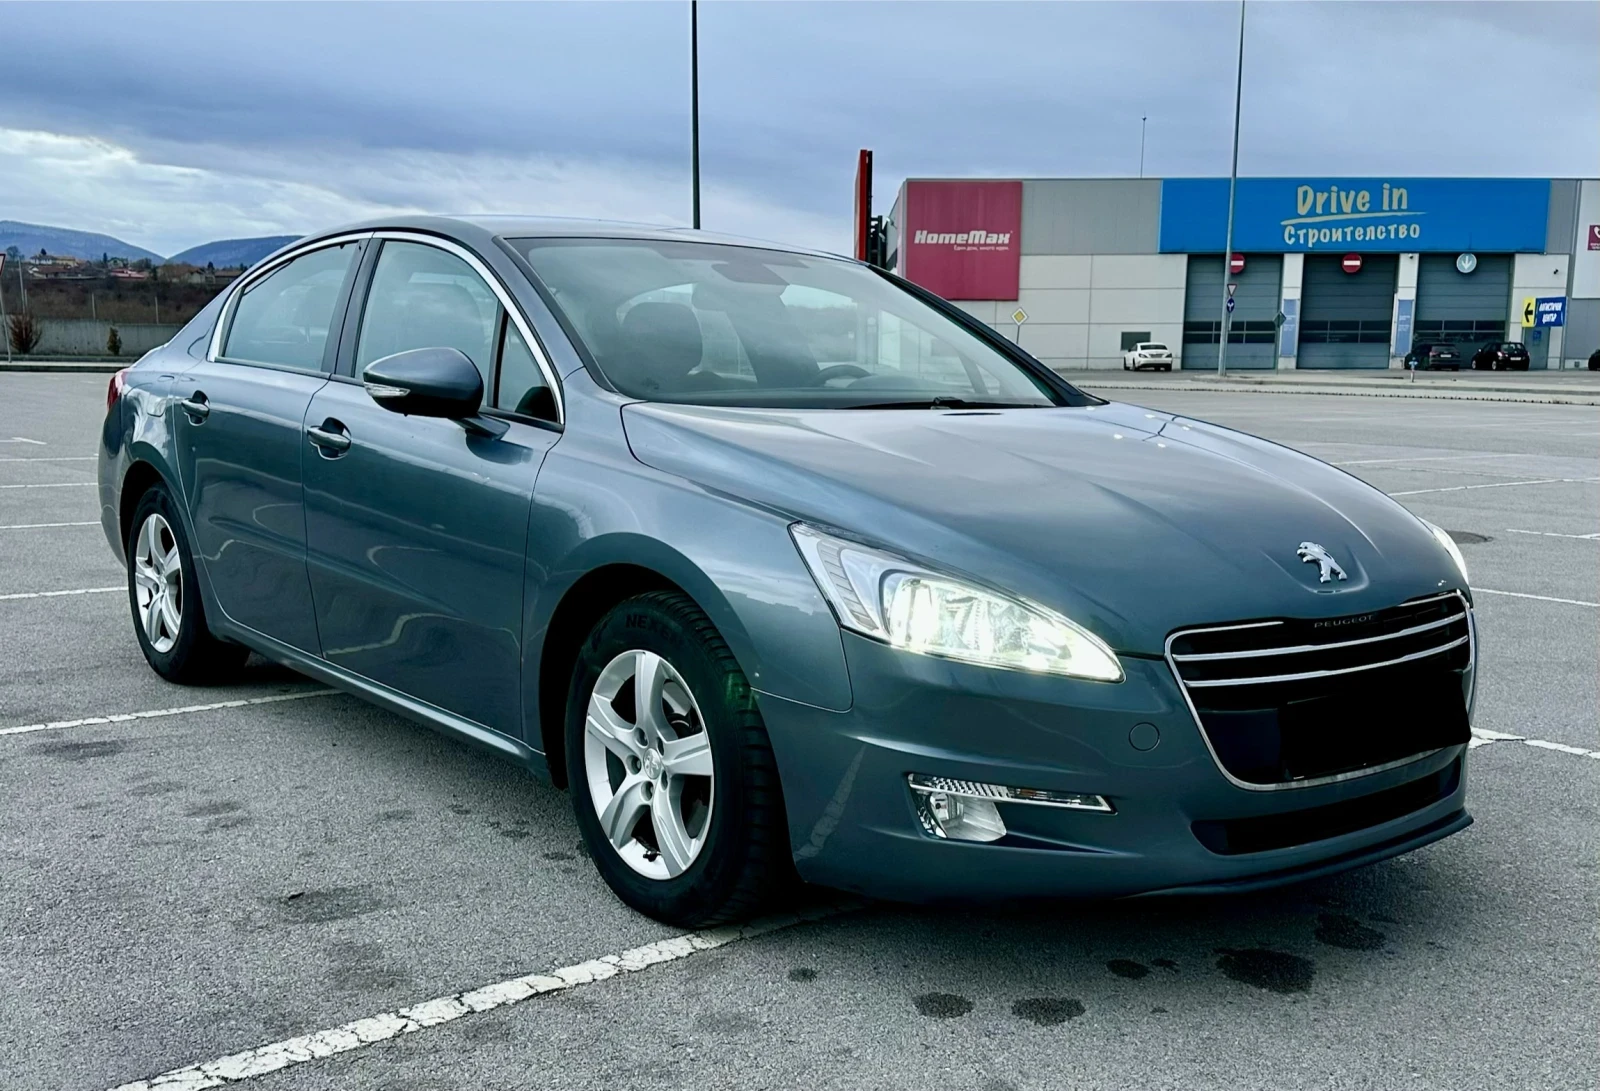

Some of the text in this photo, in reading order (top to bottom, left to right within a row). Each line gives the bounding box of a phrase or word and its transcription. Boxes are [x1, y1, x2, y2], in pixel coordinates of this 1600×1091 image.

[1297, 183, 1408, 216] Drive in
[914, 230, 1011, 244] HomeMax
[1284, 223, 1421, 248] Строителство
[1314, 614, 1374, 628] PEUGEOT
